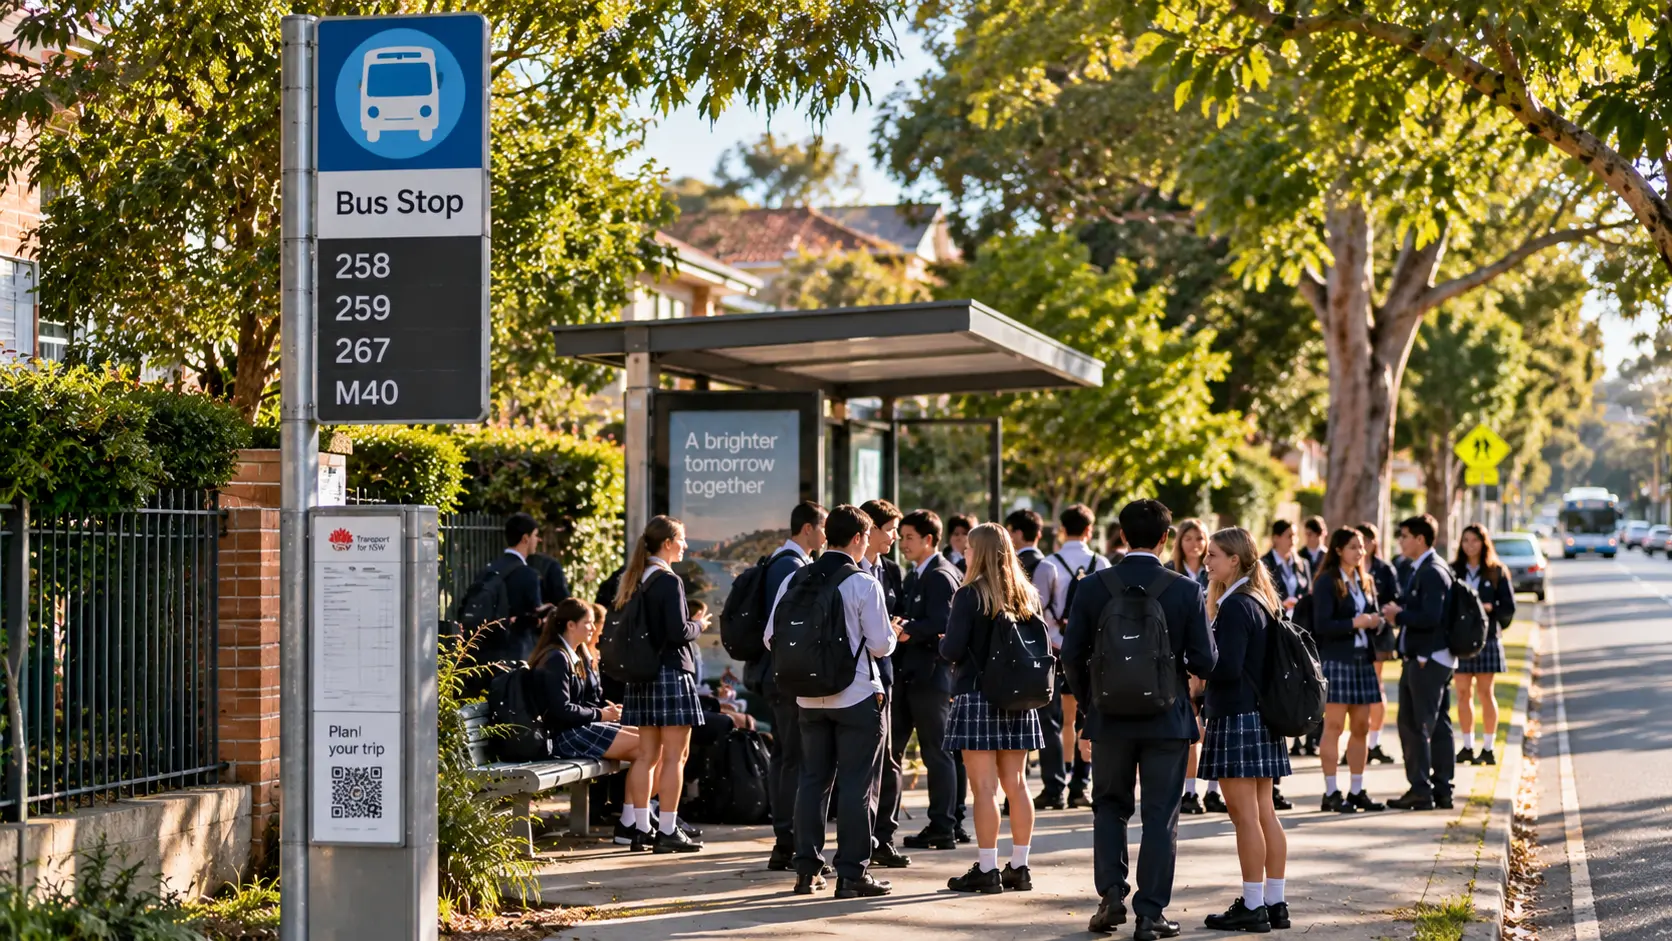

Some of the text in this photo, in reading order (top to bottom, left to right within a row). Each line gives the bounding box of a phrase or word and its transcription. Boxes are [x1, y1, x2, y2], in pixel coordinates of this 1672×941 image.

[336, 189, 464, 219] Bus Stop
[335, 253, 391, 279] 258
[335, 295, 391, 321] 259
[335, 338, 391, 364] 267
[336, 380, 399, 405] M40
[685, 431, 779, 454] A brighter
[684, 455, 776, 472] tomorrow
[684, 476, 765, 499] together
[328, 742, 385, 757] your trip
